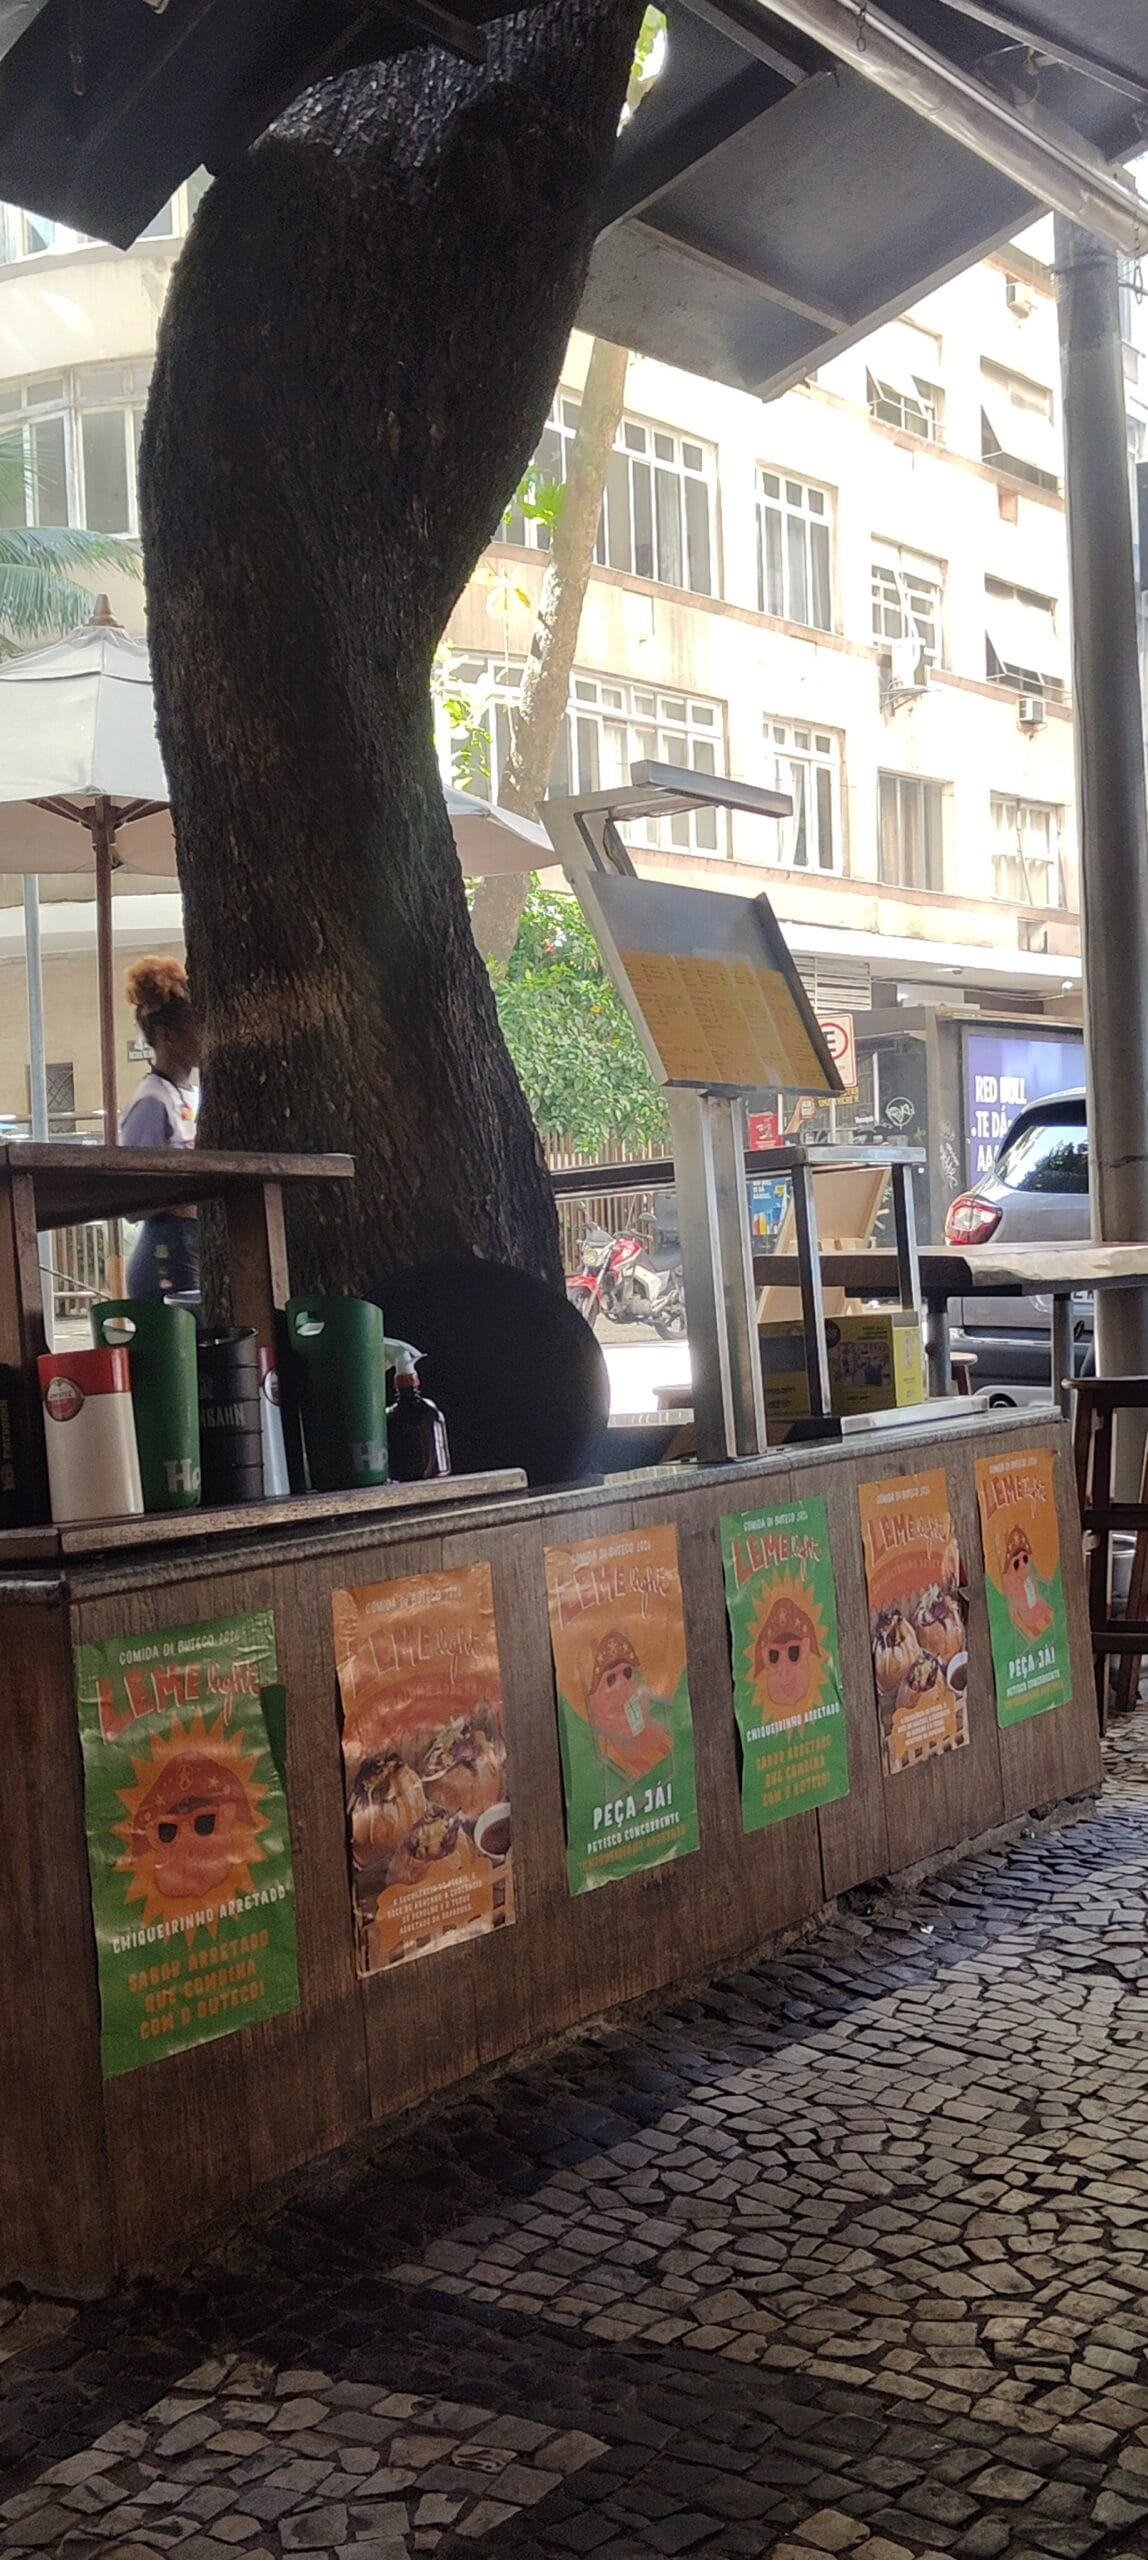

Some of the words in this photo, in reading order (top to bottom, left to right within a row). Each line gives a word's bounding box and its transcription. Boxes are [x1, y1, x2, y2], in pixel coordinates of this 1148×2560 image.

[975, 1075, 998, 1103] RED
[999, 1076, 1027, 1104] BULL
[976, 1111, 990, 1138] TE
[991, 1106, 1008, 1138] DÁ
[731, 1534, 790, 1590] LEME
[866, 1513, 915, 1568] LEME
[554, 1562, 626, 1631] LEME
[119, 1645, 159, 1665] COMIDA
[163, 1642, 174, 1657] DI
[1008, 1653, 1035, 1679] PEÇA
[1038, 1643, 1055, 1668] JÁ!
[96, 1663, 201, 1745] LEME
[593, 1795, 636, 1830] PEÇA
[643, 1780, 672, 1813] JÁ!
[587, 1832, 622, 1854] PETISCO
[624, 1812, 680, 1841] CONCORRENTE
[112, 1908, 215, 1954] CHIQUEIRINHO
[219, 1884, 287, 1919] ARRETADO
[128, 1959, 181, 1993] SABOR
[187, 1929, 270, 1972] ARRETADO
[144, 1986, 178, 2013] QUE
[183, 1959, 256, 1998] COMBINA
[140, 2012, 175, 2040] COM
[180, 2006, 191, 2025] O
